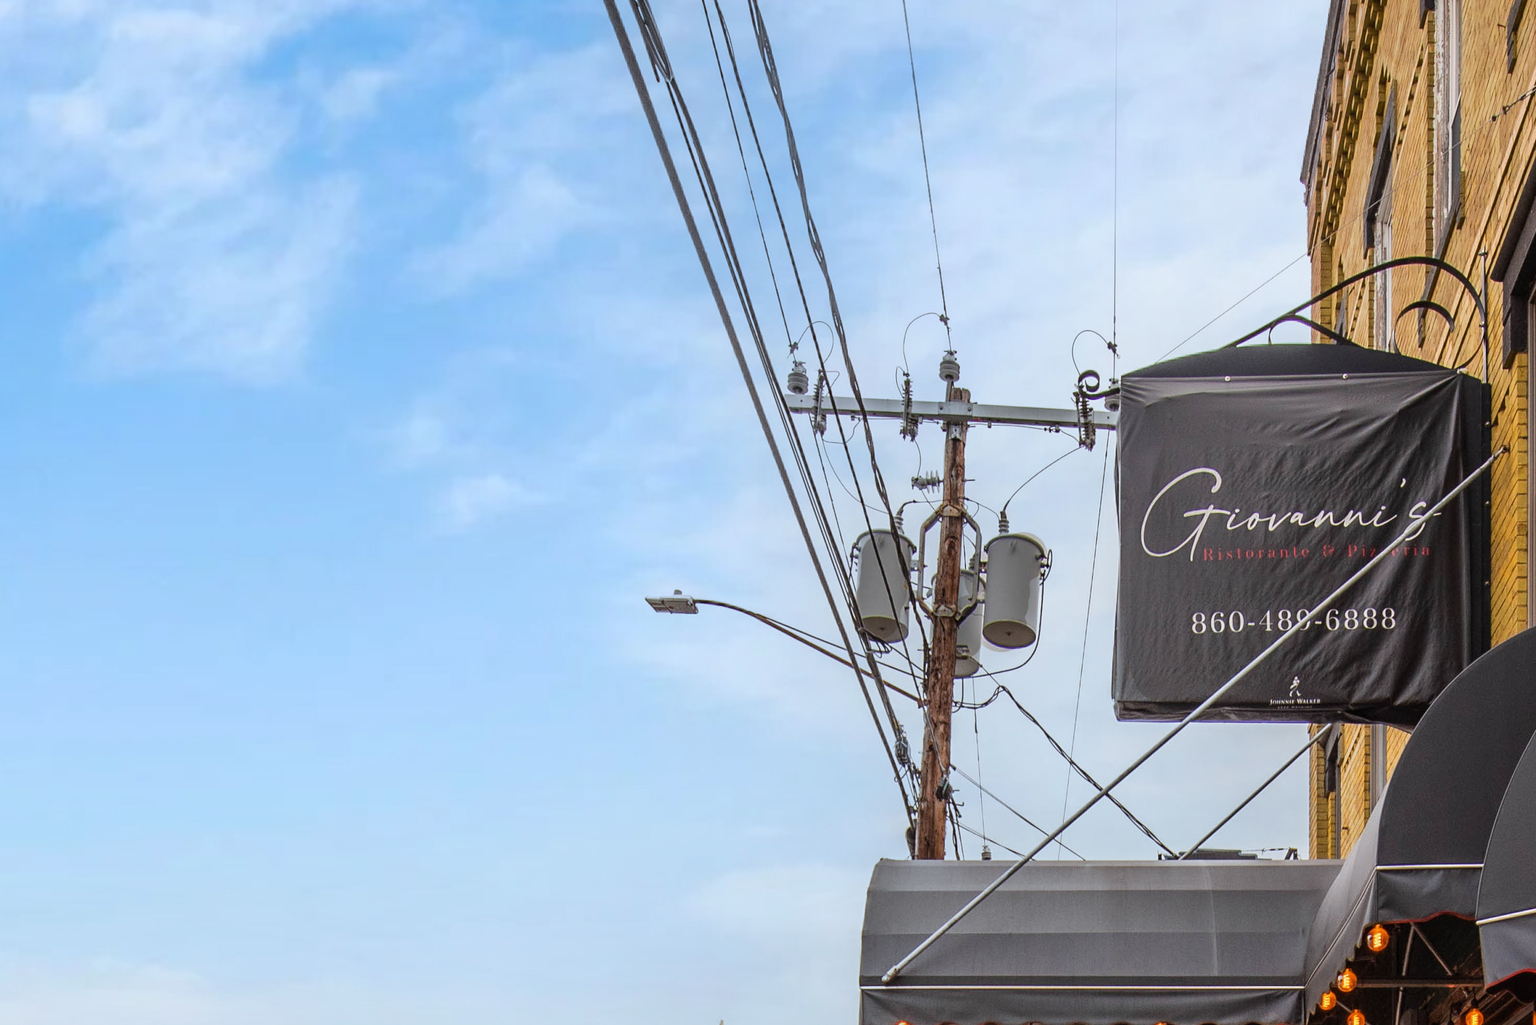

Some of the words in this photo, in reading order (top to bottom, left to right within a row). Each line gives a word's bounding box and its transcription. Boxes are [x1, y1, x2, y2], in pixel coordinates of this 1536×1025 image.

[1140, 467, 1442, 562] Giovanni's
[1203, 545, 1310, 562] Ristorante
[1322, 544, 1335, 558] &
[1347, 544, 1431, 559] Pizeria
[1190, 607, 1397, 634] 860-489-6888
